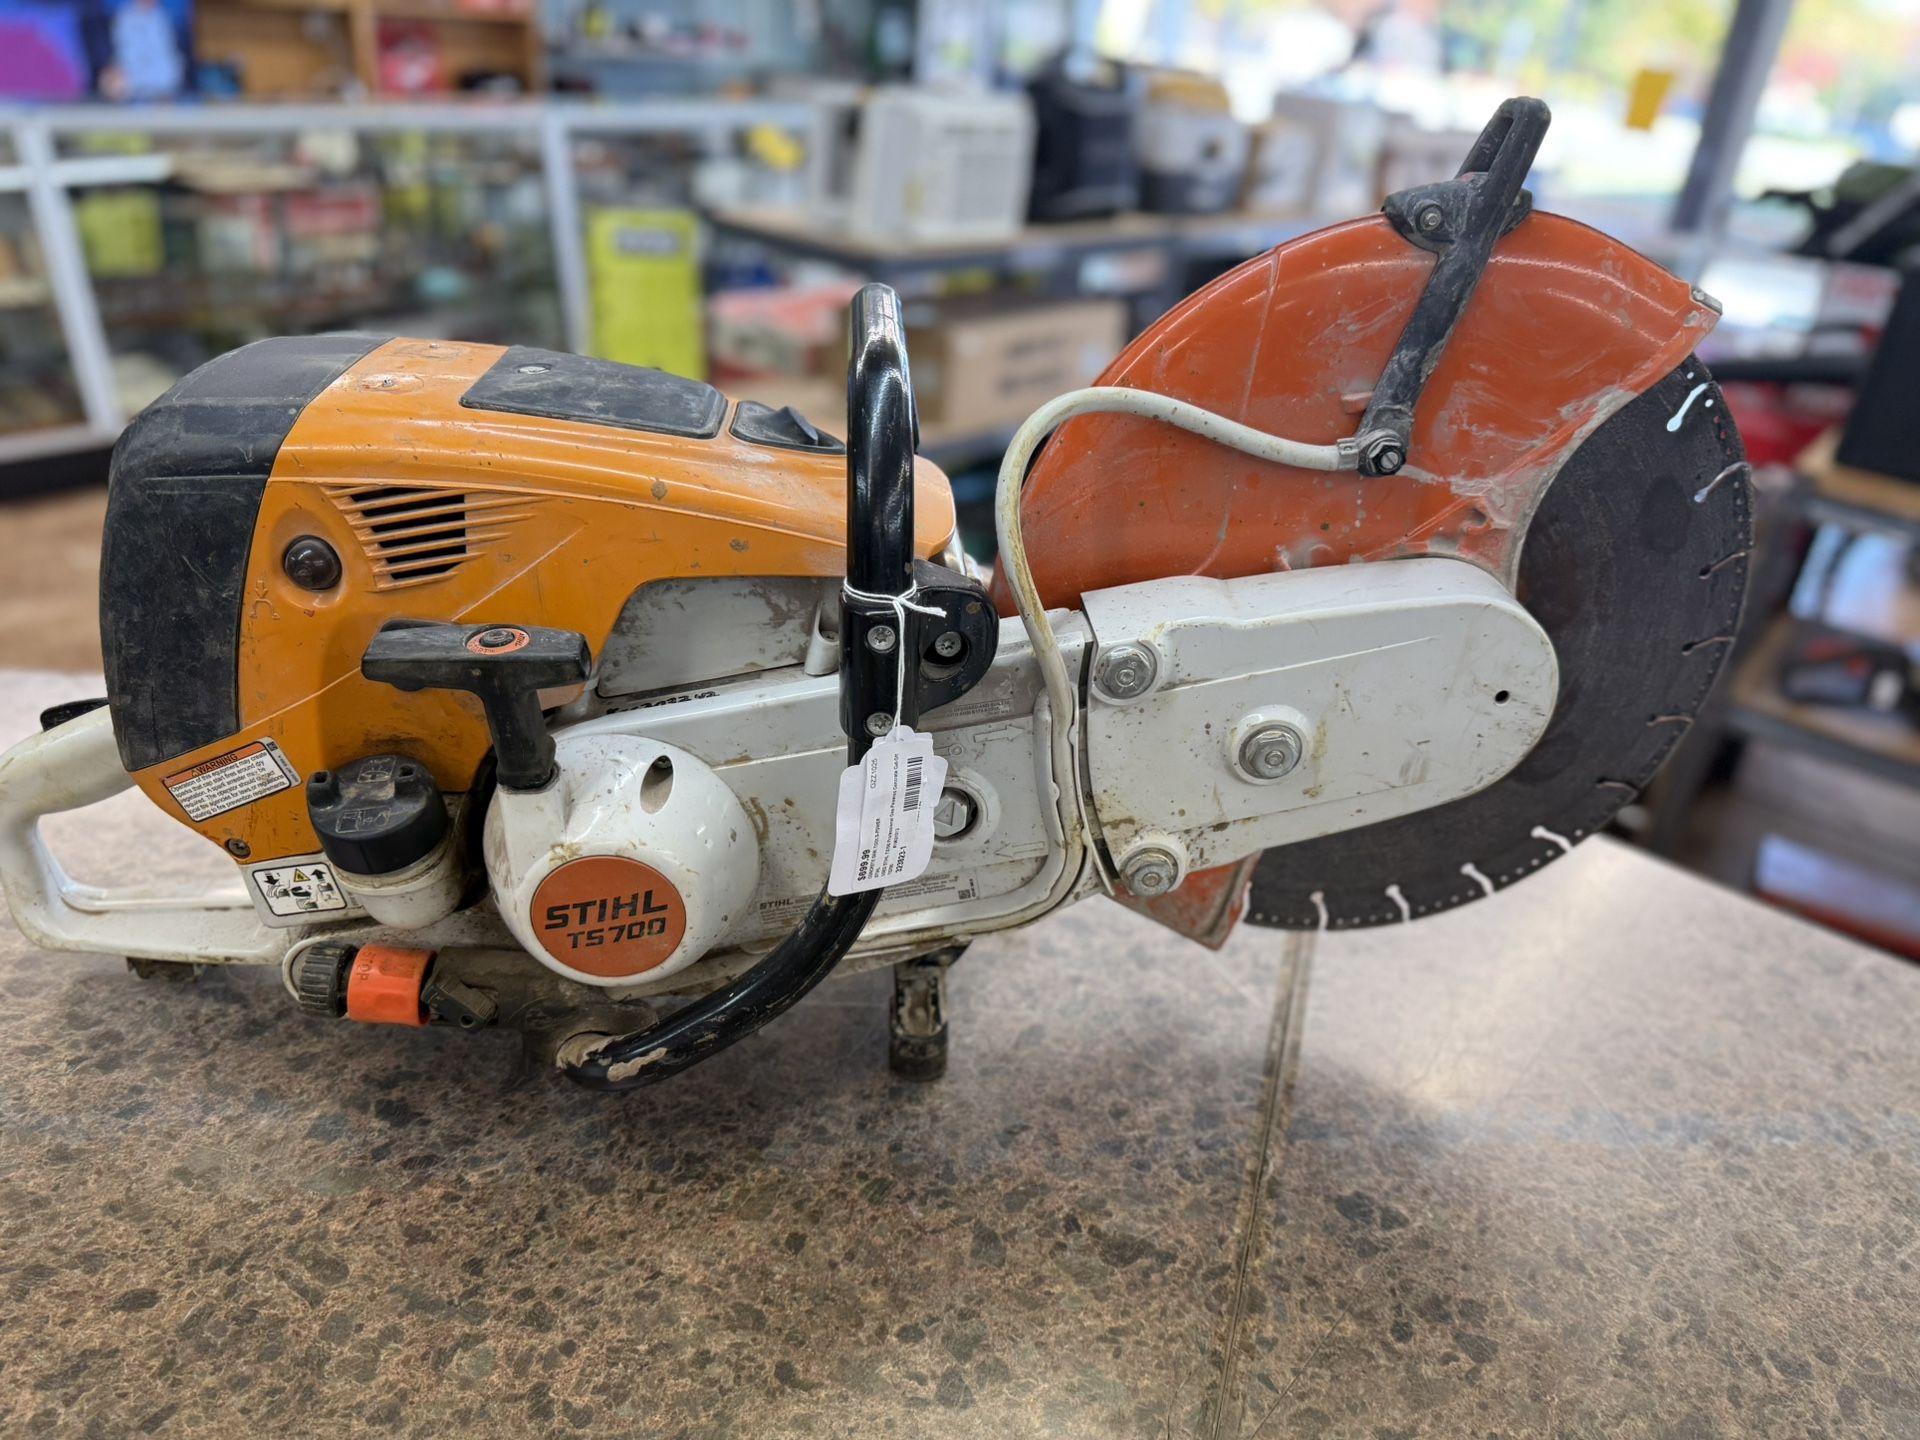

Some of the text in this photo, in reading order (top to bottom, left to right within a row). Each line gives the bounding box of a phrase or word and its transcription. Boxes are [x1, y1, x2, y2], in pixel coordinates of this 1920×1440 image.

[196, 753, 238, 773] WARNING
[171, 781, 196, 792] Operation
[211, 764, 239, 776] equipment
[175, 789, 193, 797] sparks
[217, 786, 238, 796] operator
[192, 811, 211, 819] relating
[226, 795, 253, 806] prevention
[857, 849, 871, 882] $699.99
[545, 890, 668, 930] STIHL
[759, 898, 794, 910] STIHL
